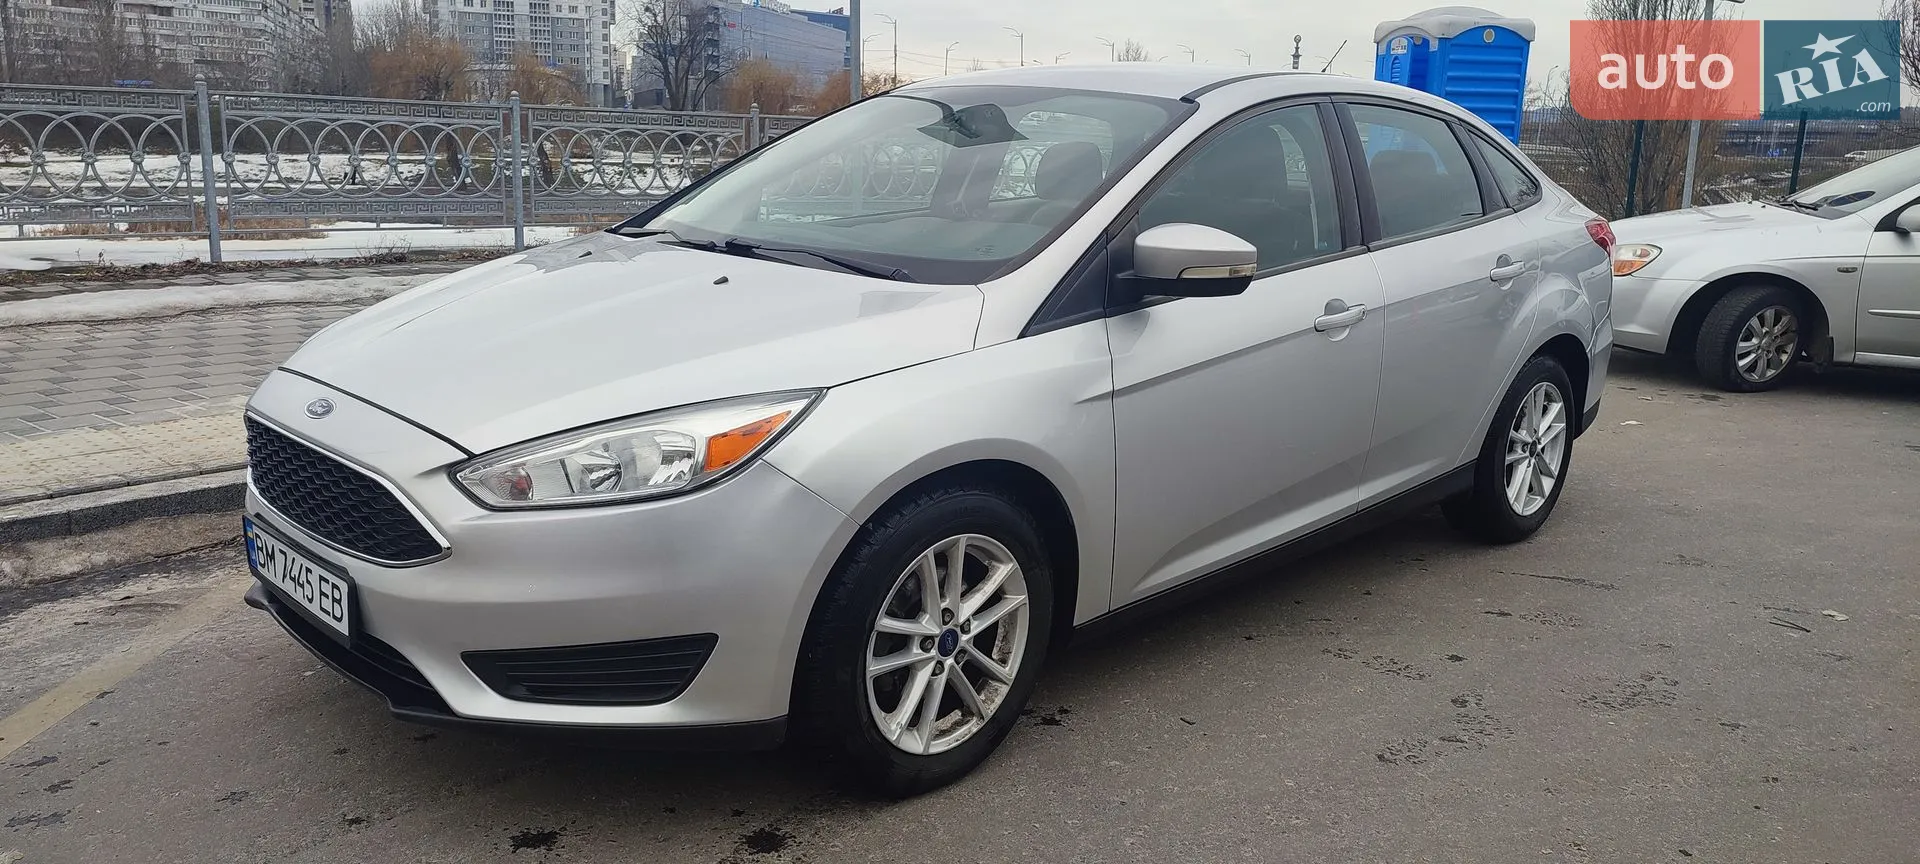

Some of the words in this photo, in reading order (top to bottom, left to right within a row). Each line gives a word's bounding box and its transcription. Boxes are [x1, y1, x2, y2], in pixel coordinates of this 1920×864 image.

[254, 532, 277, 579] BM
[278, 548, 314, 604] 7445
[318, 574, 343, 623] EB
